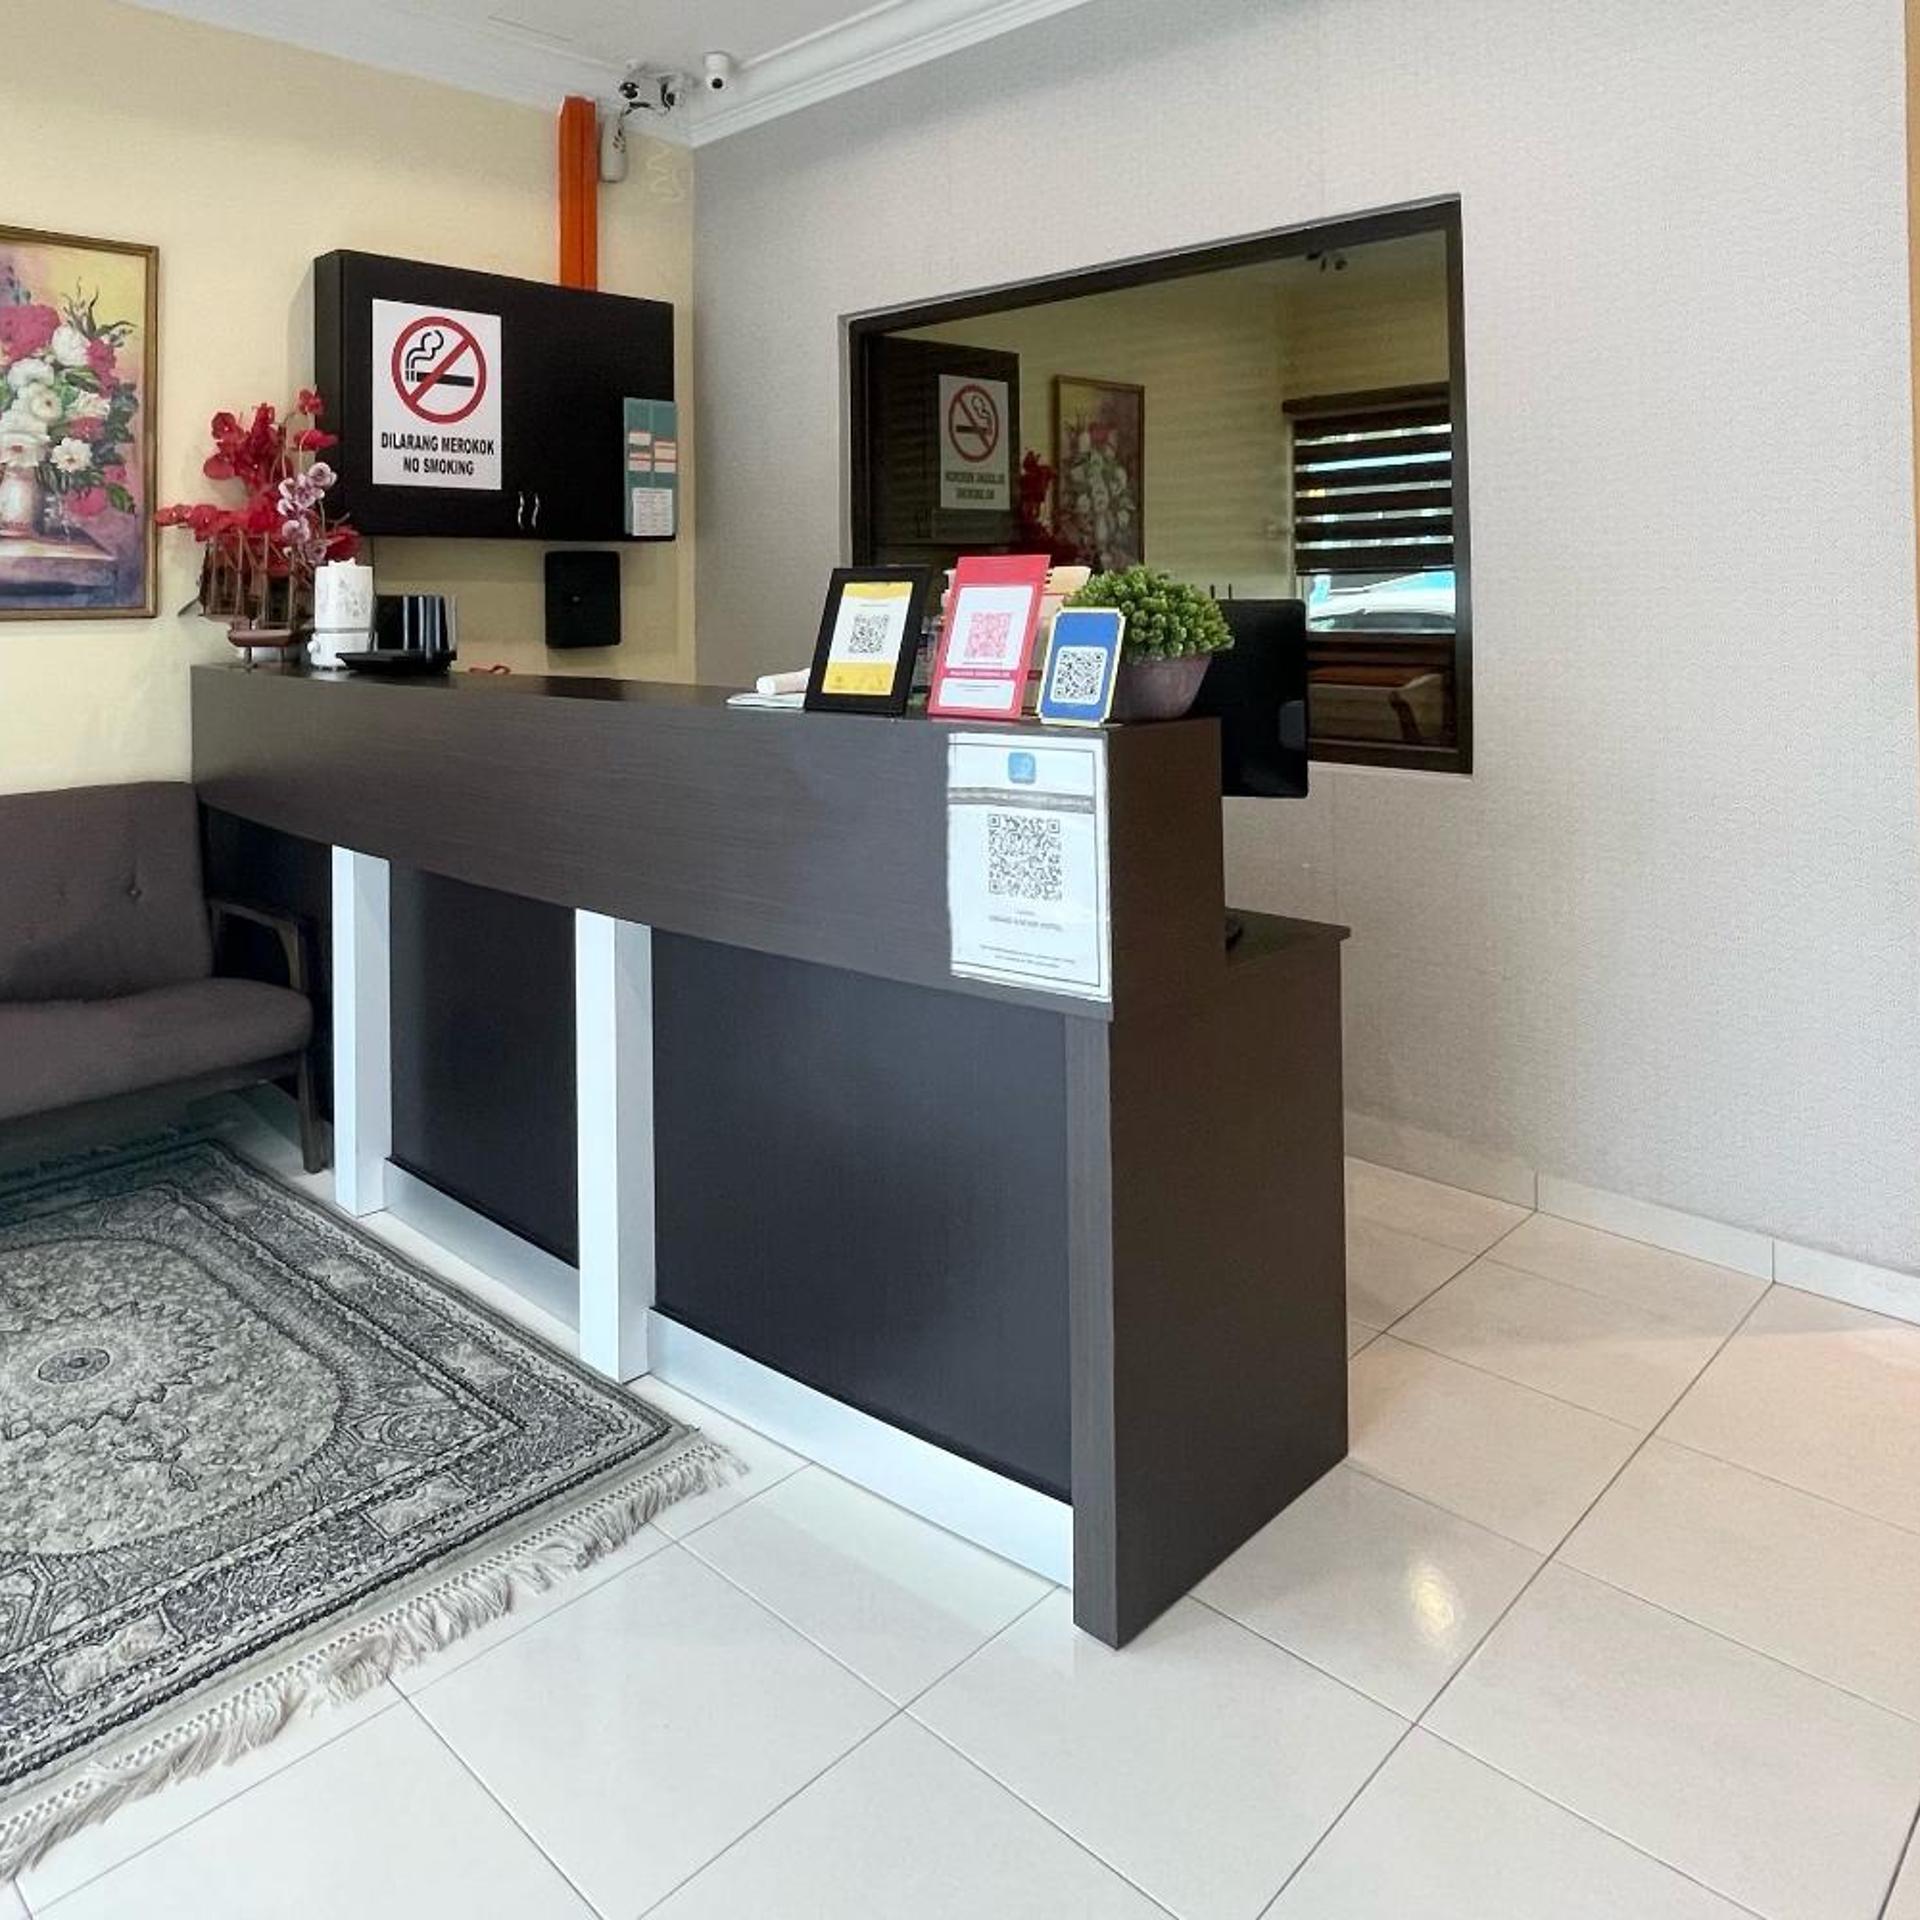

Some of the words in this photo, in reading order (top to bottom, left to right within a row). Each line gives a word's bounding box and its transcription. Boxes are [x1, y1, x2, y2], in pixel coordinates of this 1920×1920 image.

[381, 432, 438, 452] DILARANG
[441, 437, 495, 456] MEROKOK
[403, 457, 420, 473] NO
[423, 458, 475, 476] SMOKING
